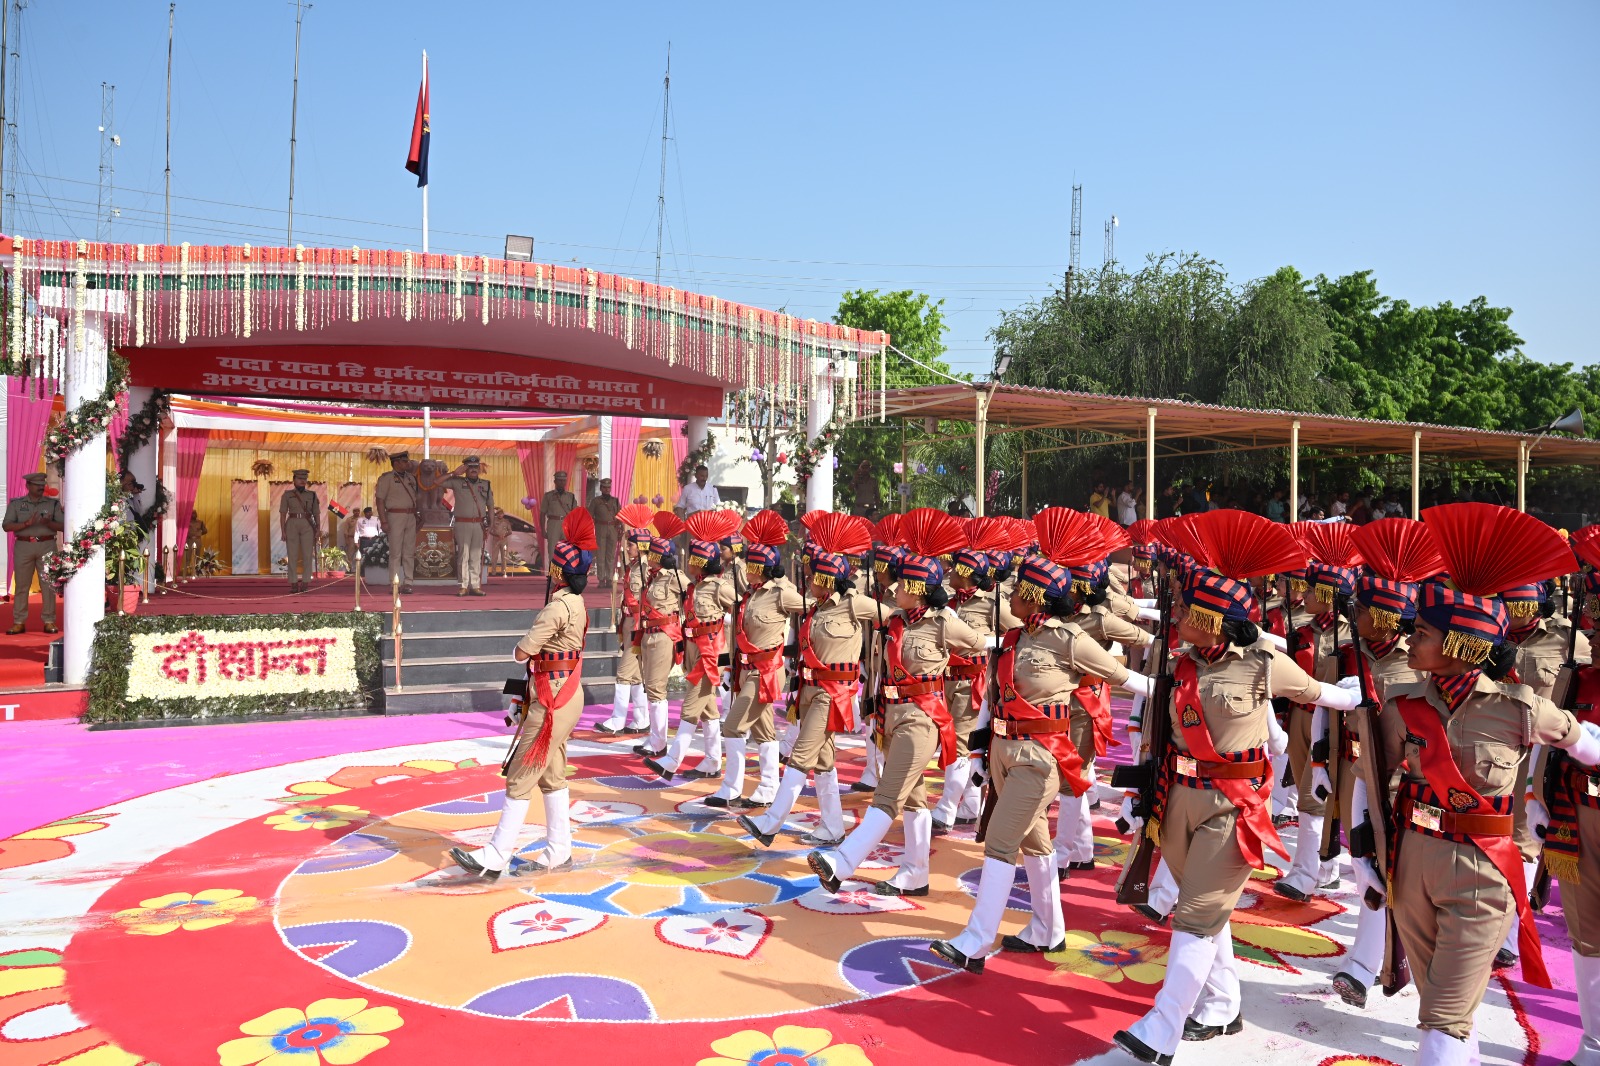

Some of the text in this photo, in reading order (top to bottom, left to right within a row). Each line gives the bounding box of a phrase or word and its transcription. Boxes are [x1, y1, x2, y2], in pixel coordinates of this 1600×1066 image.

[216, 356, 273, 372] यदा
[277, 360, 333, 376] यदा
[336, 362, 366, 377] हि
[373, 366, 447, 382] धर्मस्य
[451, 371, 582, 390] ग्लानिर्भवति
[587, 379, 640, 393] भारत
[430, 386, 530, 402] तदात्मानं
[534, 391, 645, 411] सृजाम्यहम्
